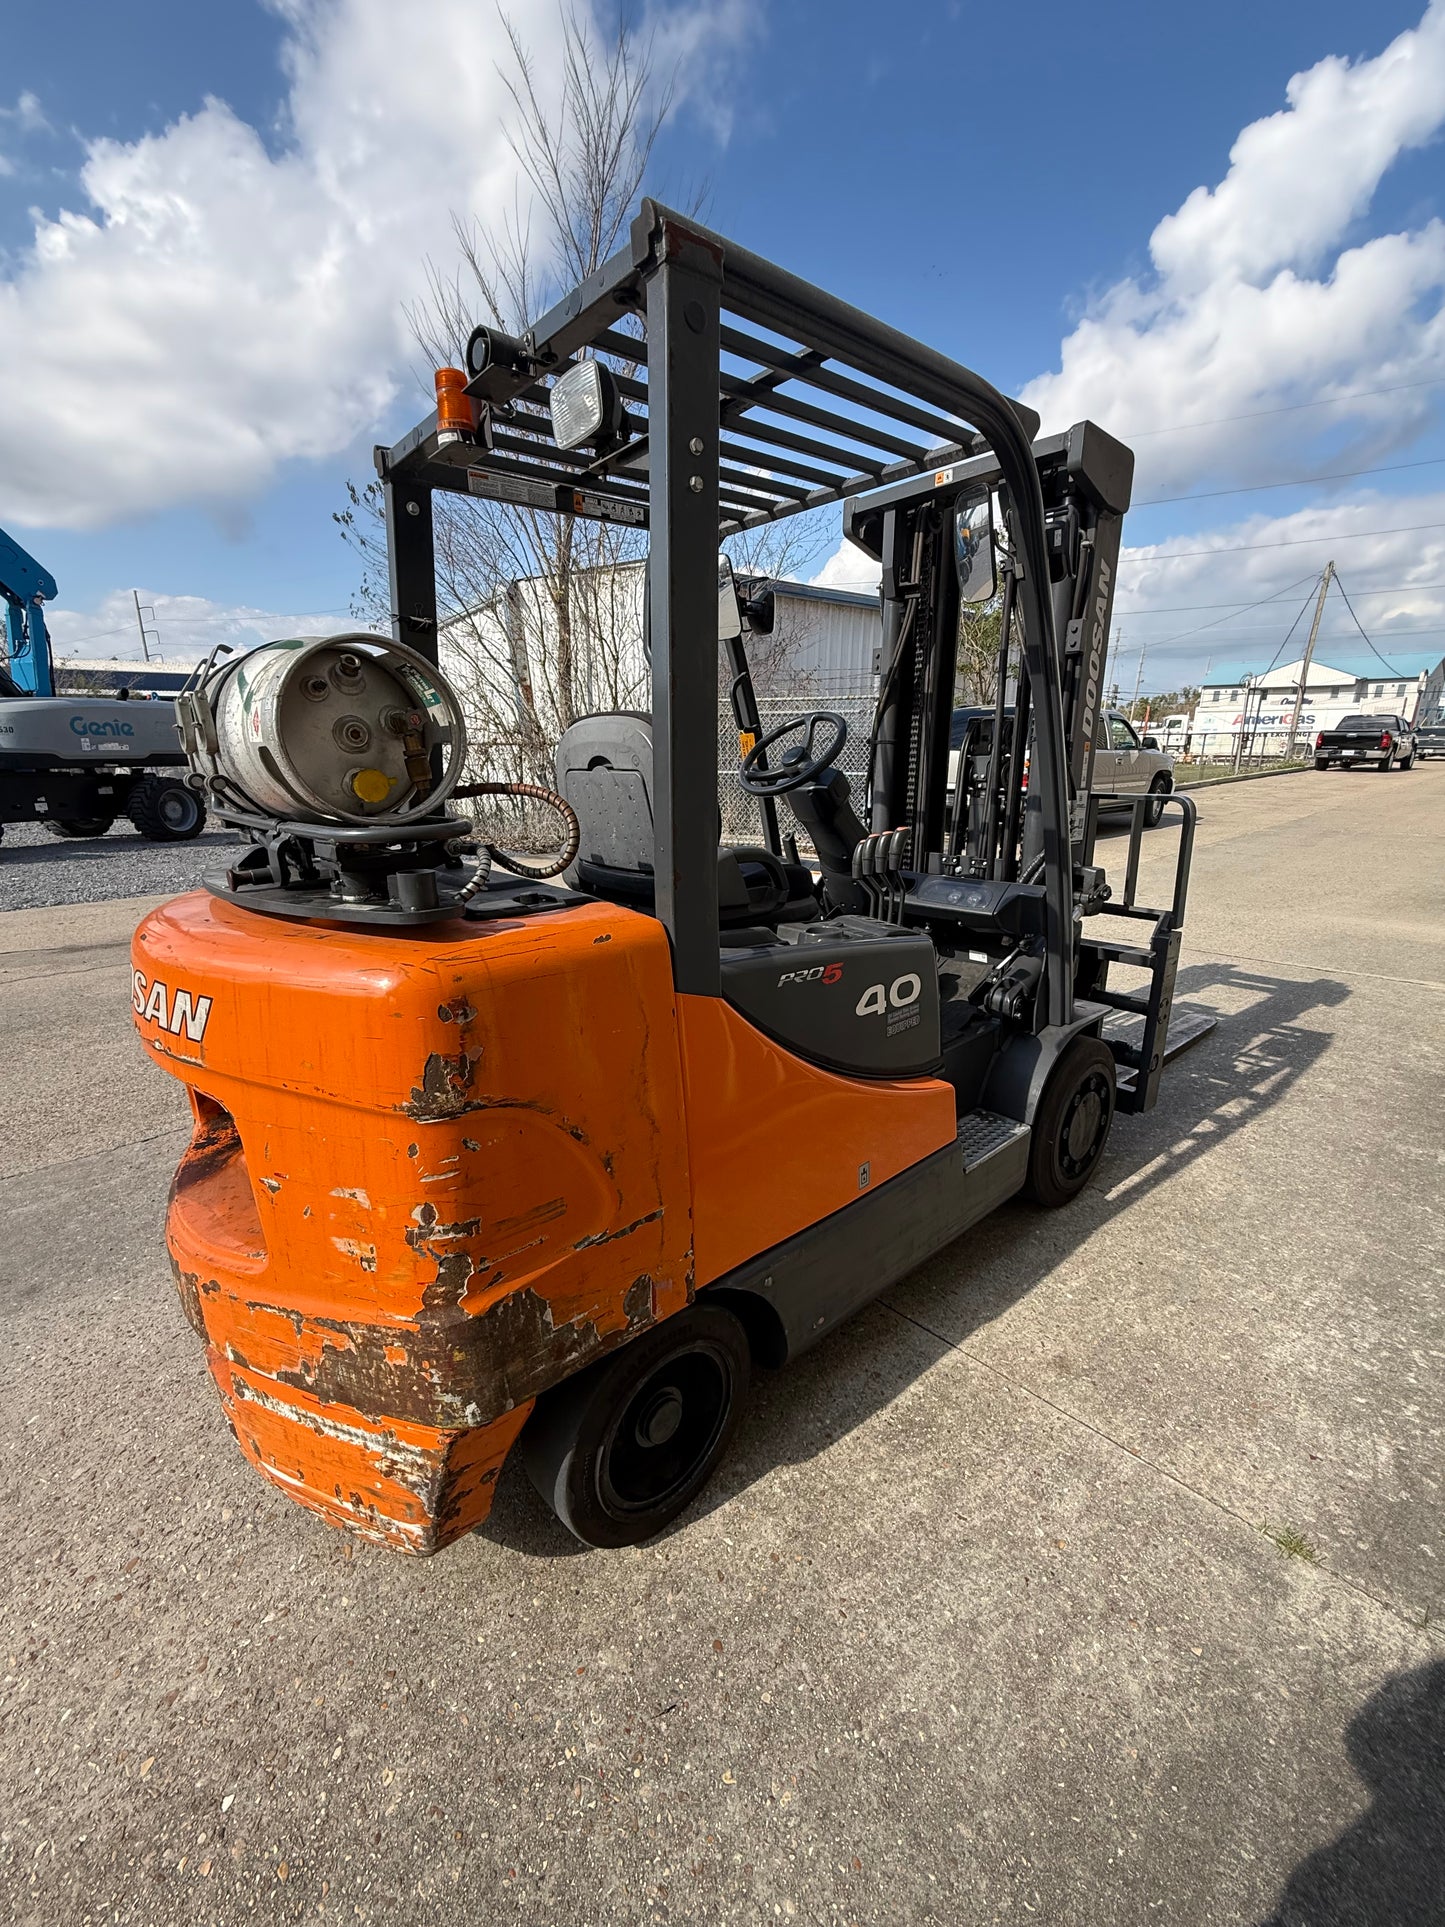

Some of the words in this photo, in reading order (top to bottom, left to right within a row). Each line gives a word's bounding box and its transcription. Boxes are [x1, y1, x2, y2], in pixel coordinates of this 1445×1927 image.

[1082, 558, 1111, 739] DOOSAN
[69, 716, 135, 737] Genie
[777, 962, 845, 988] PRO5
[855, 972, 922, 1016] 40
[131, 963, 213, 1043] SAN
